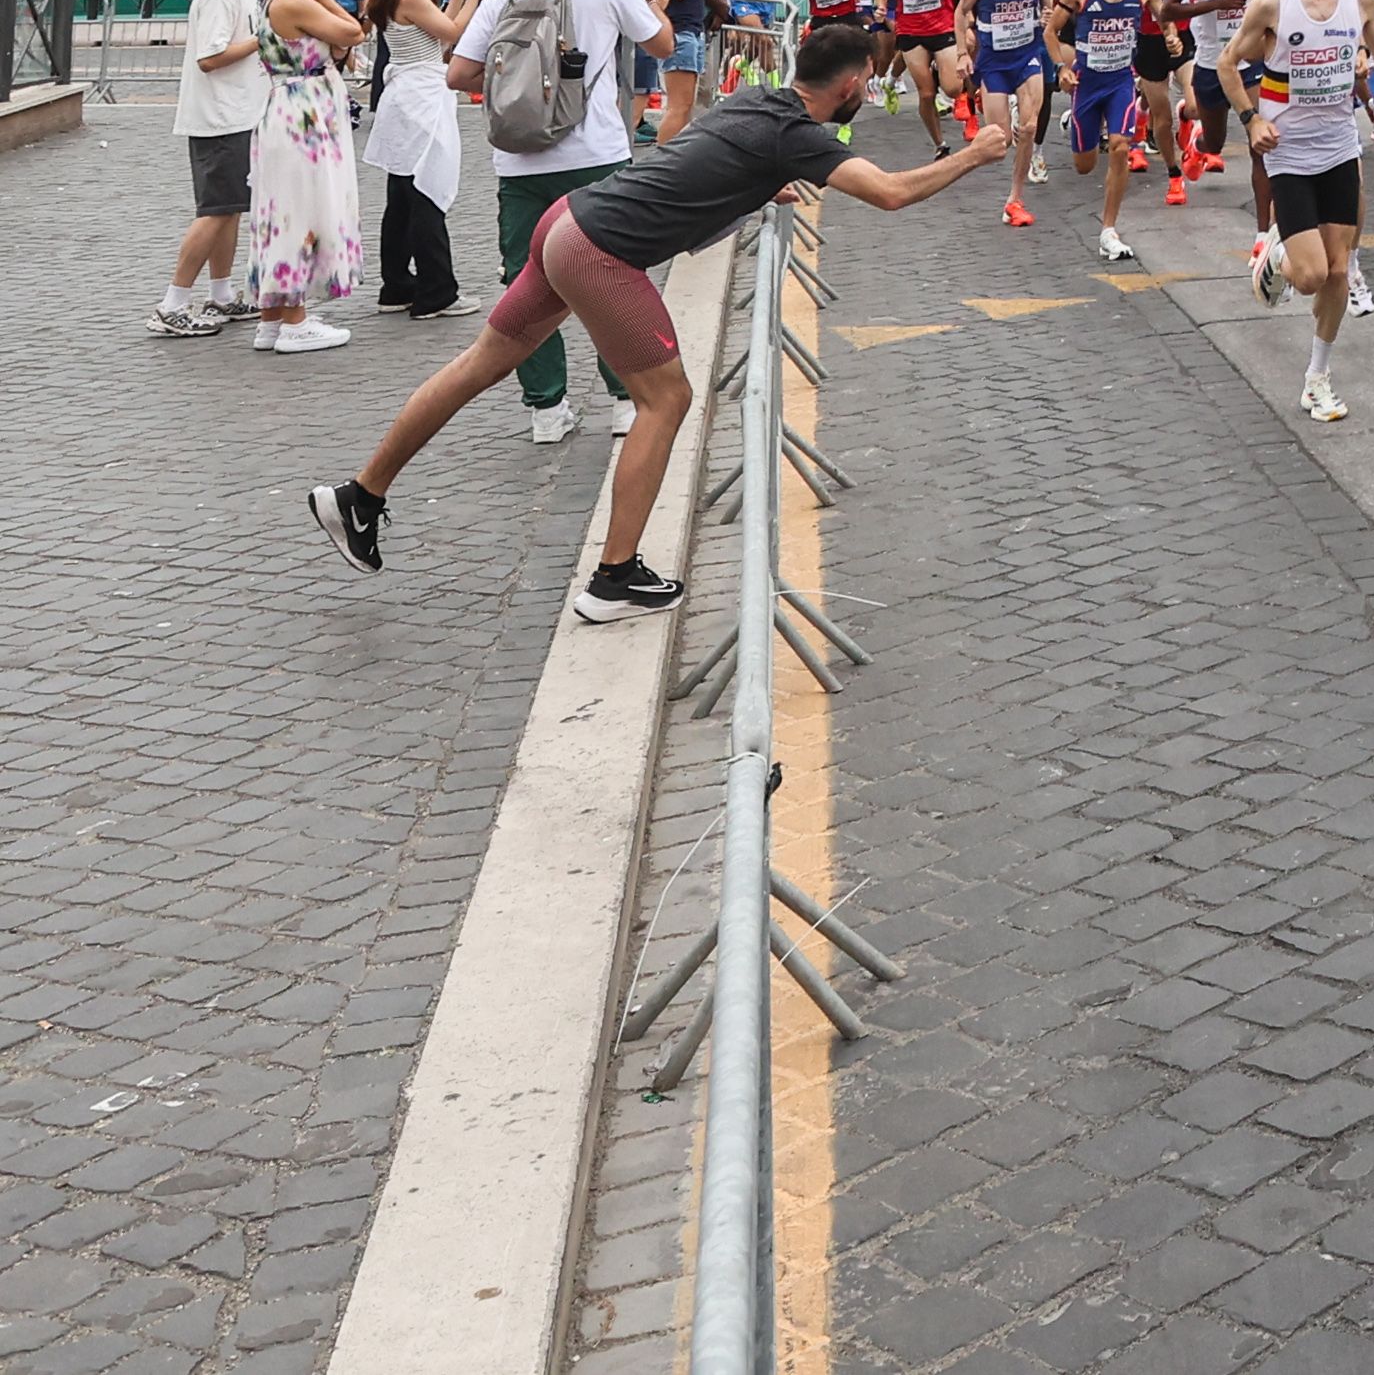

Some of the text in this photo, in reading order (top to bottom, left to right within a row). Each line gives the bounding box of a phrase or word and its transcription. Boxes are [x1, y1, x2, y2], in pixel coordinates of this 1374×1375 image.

[995, 0, 1034, 13] FRANCE
[992, 13, 1025, 24] SPAR
[1218, 7, 1247, 20] SPA
[1092, 17, 1135, 32] FRANCE
[1091, 33, 1123, 43] SPAR
[1091, 43, 1131, 53] NAVARRO
[1291, 49, 1336, 64] SPAR
[1291, 62, 1353, 79] DEBOGNIES
[1298, 93, 1347, 105] ROMA 2024
